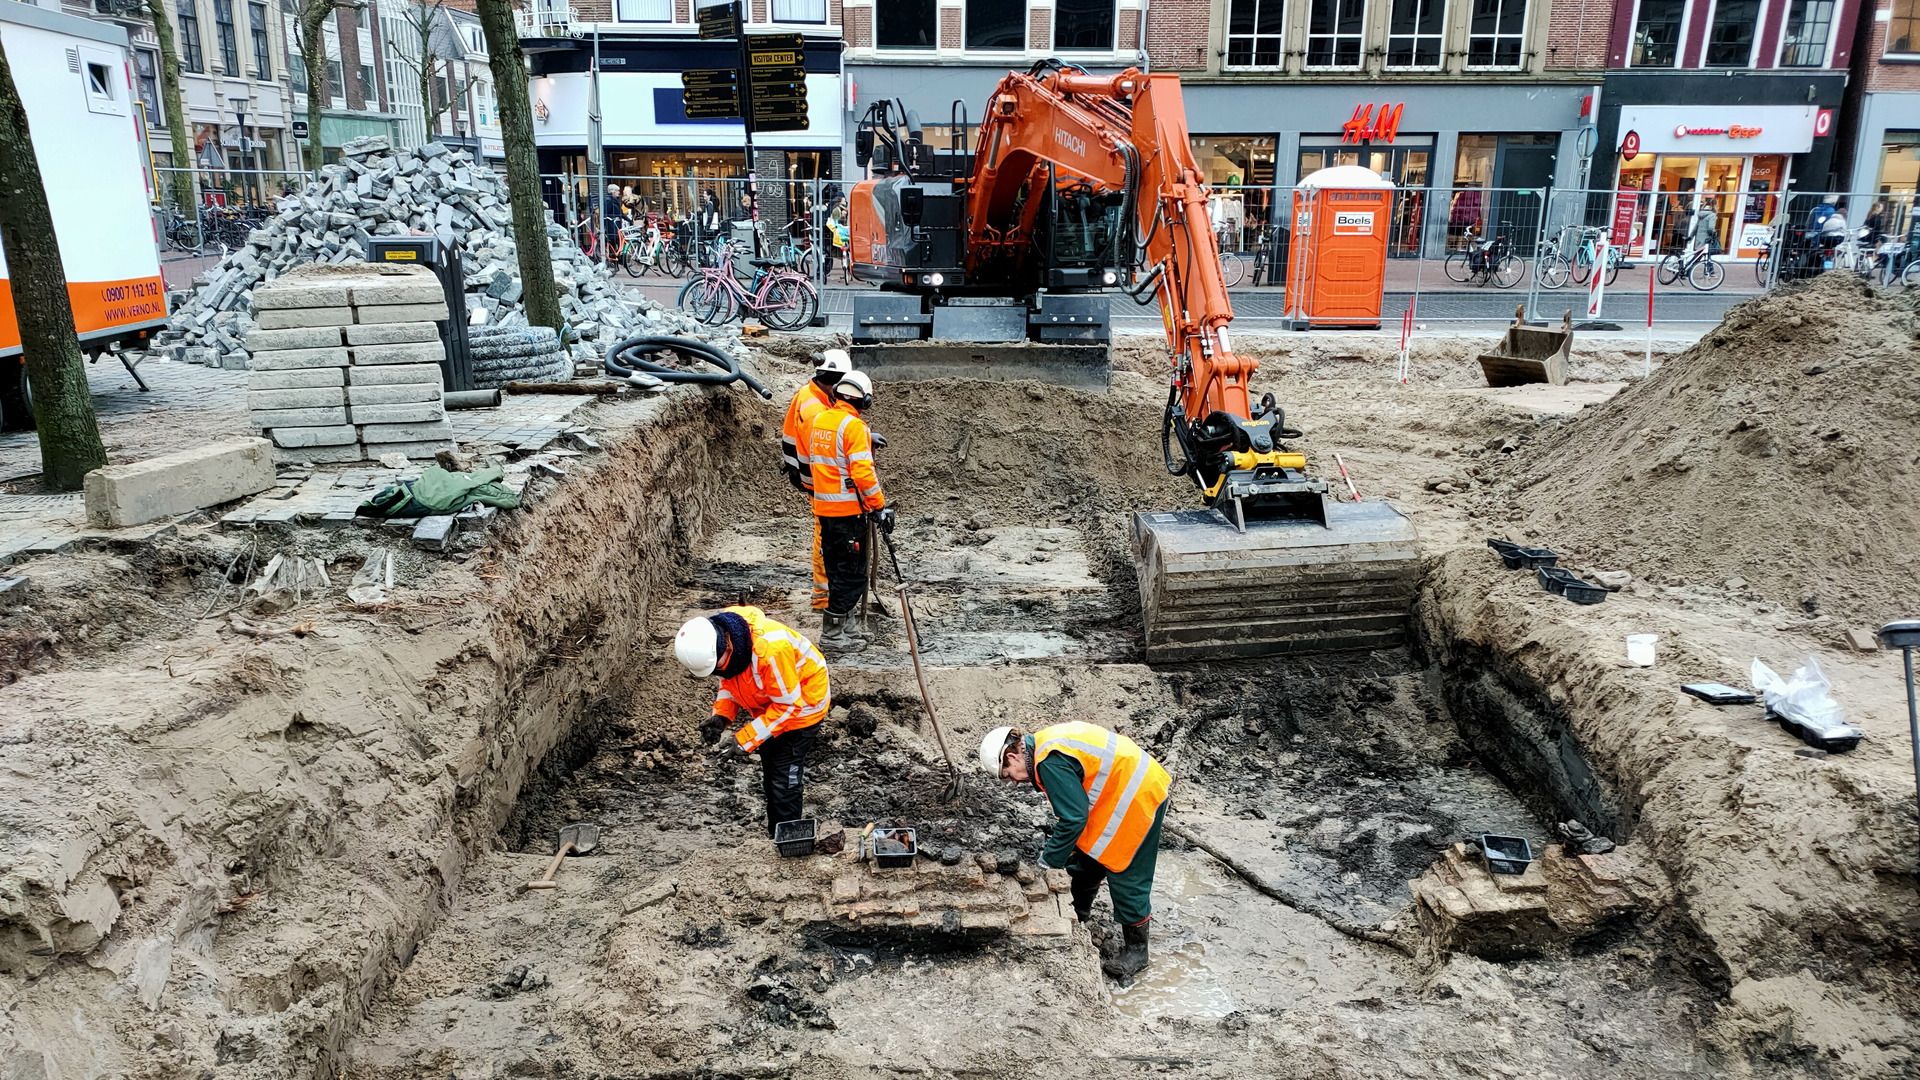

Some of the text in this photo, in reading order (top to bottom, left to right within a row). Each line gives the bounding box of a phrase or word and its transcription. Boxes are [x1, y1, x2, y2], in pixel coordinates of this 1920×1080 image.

[753, 53, 793, 63] VISITOR CENTER
[1342, 103, 1404, 144] H&M
[1054, 126, 1086, 158] HITACHI
[1337, 216, 1371, 225] Boels
[106, 287, 125, 302] 0900
[131, 284, 145, 298] 112
[145, 282, 159, 296] 112
[104, 302, 161, 321] WWW.VERNO.NL
